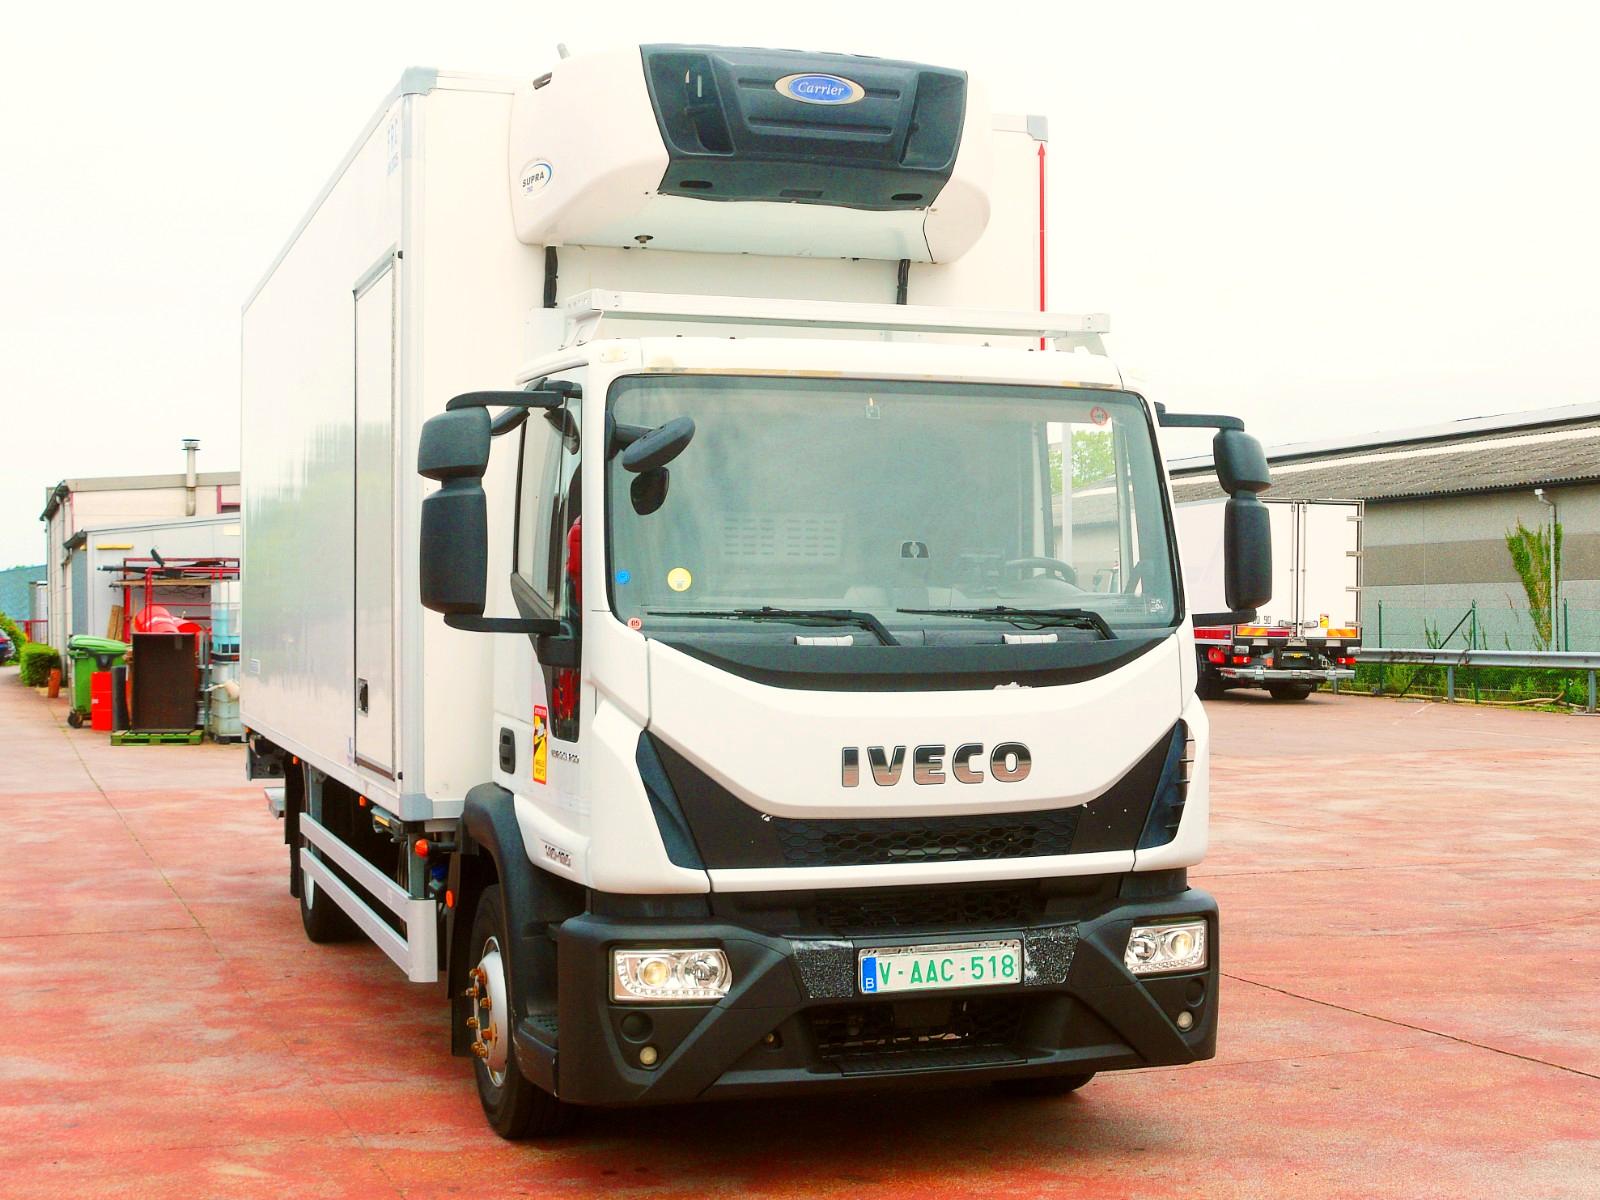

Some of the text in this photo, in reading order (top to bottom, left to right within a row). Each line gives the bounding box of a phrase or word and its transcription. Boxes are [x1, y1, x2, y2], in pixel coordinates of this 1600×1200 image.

[798, 81, 844, 96] Carrier
[522, 171, 545, 188] SUPRA
[842, 742, 1032, 787] IVECO
[865, 954, 1015, 989] B V-AAC-518
